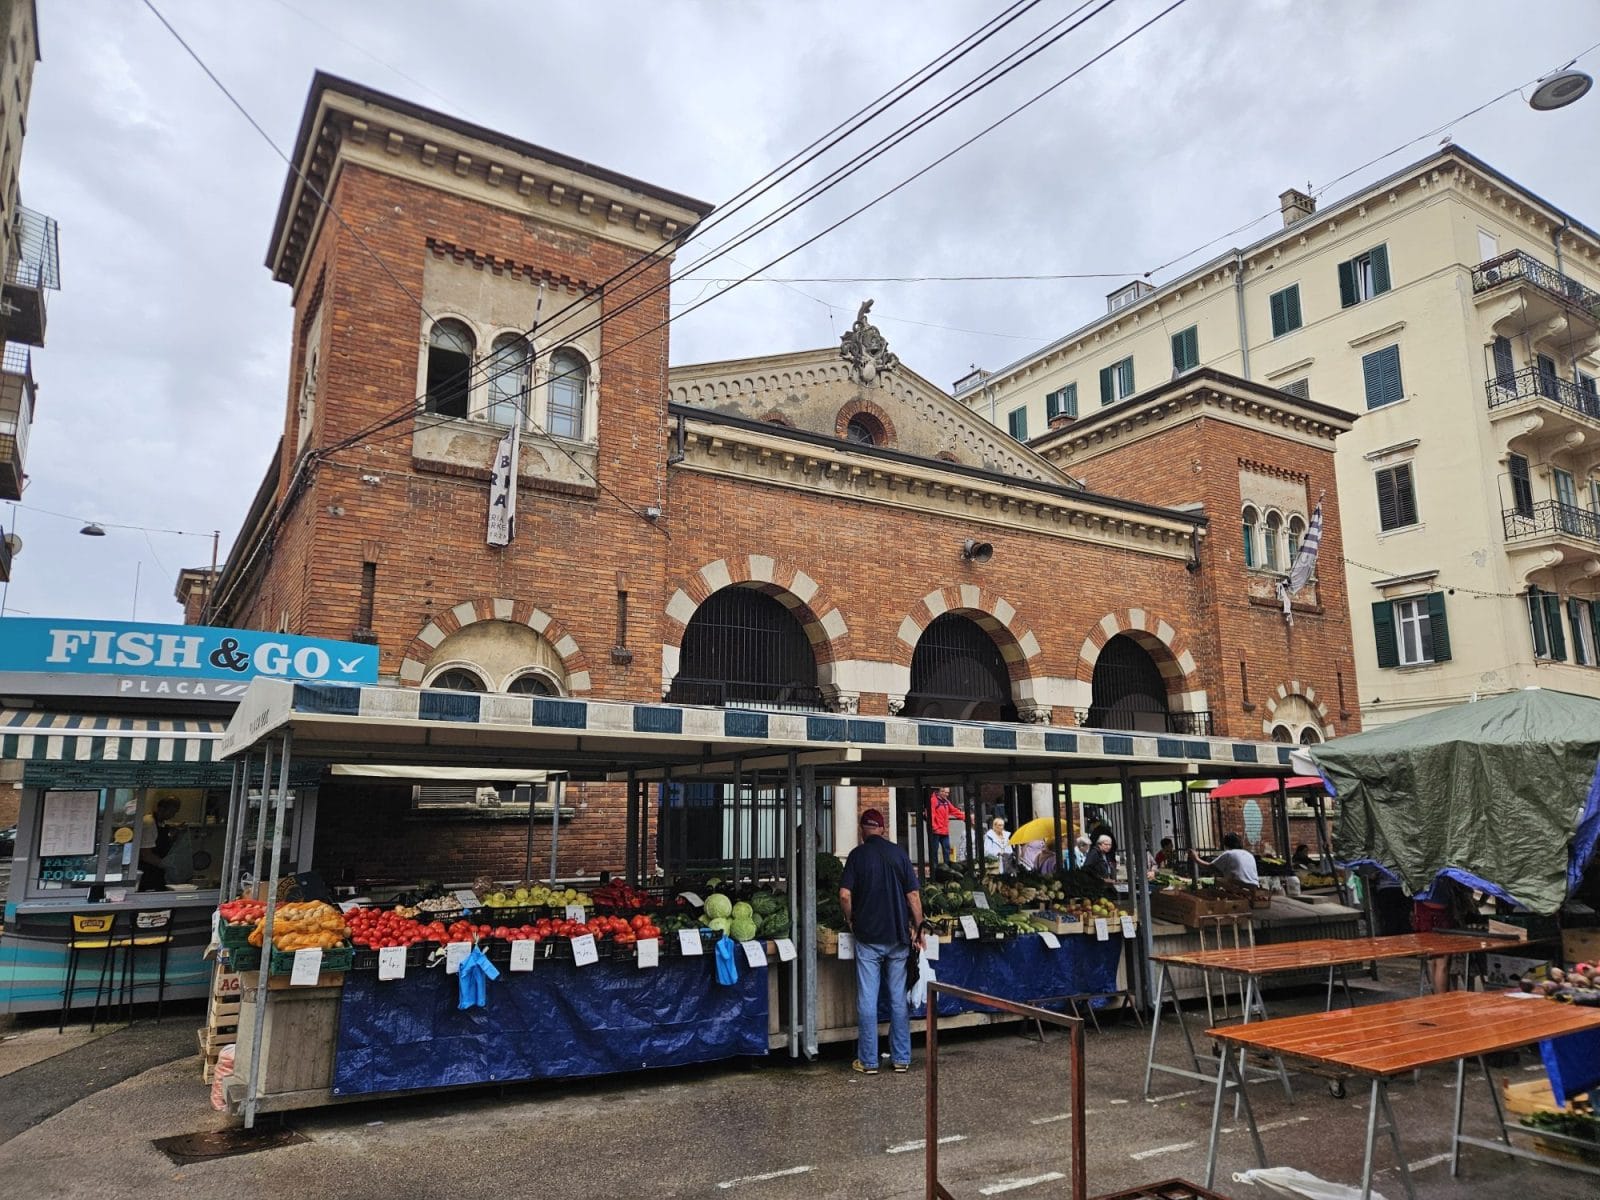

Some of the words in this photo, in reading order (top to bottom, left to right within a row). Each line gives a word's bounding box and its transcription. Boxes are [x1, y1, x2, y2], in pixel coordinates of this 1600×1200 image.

[46, 629, 204, 669] FISH
[209, 637, 250, 673] &
[254, 642, 331, 678] GO
[120, 680, 207, 695] PLACA
[44, 858, 82, 867] FAST
[43, 870, 87, 881] FOOD
